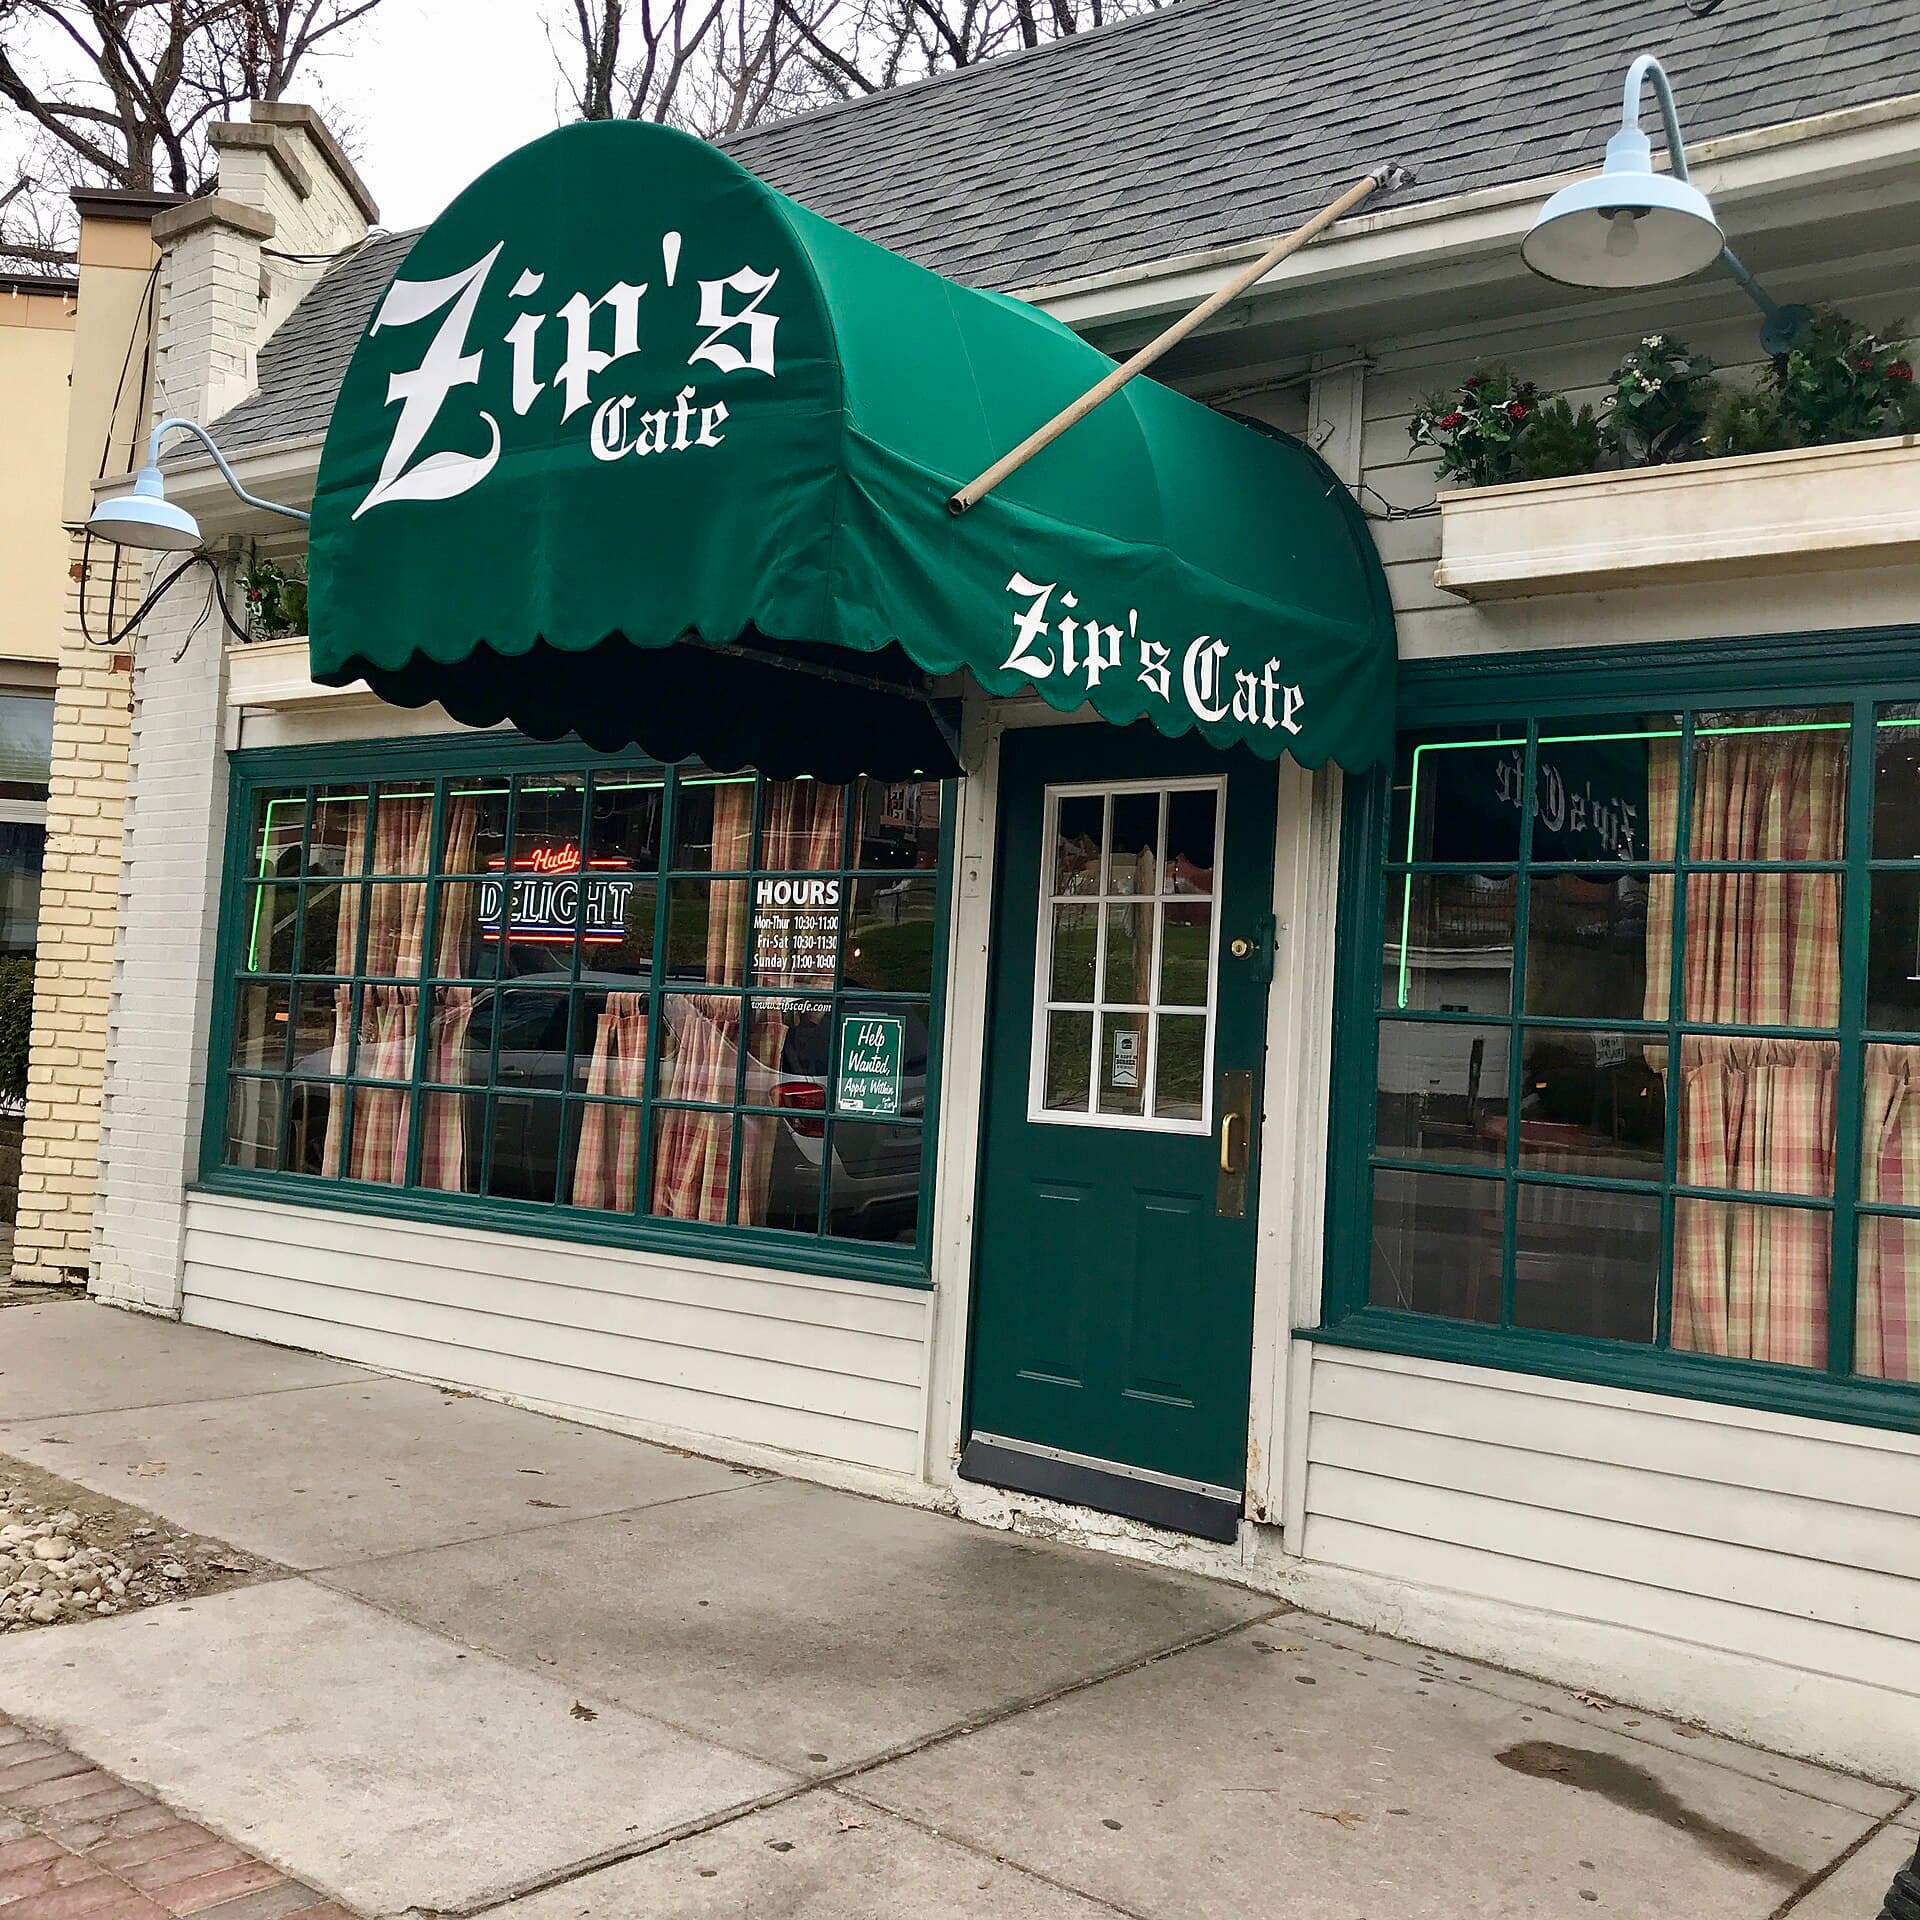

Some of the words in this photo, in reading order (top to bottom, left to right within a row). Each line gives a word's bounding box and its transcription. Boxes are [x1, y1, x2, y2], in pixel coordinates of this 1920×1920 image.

[350, 231, 782, 521] Zip's
[590, 385, 730, 461] Cafe
[999, 571, 1172, 703] Zip's
[1182, 635, 1306, 736] Cafe
[531, 843, 580, 873] Hudy
[756, 880, 840, 906] HOURS
[753, 915, 791, 930] Mon-Thur
[757, 934, 789, 949] Fri-Sat
[753, 953, 788, 971] Sunday
[751, 999, 832, 1014] www.zipscafe.com
[857, 1022, 885, 1054] Help
[848, 1049, 891, 1077] Wanted,
[844, 1077, 867, 1098] Apply
